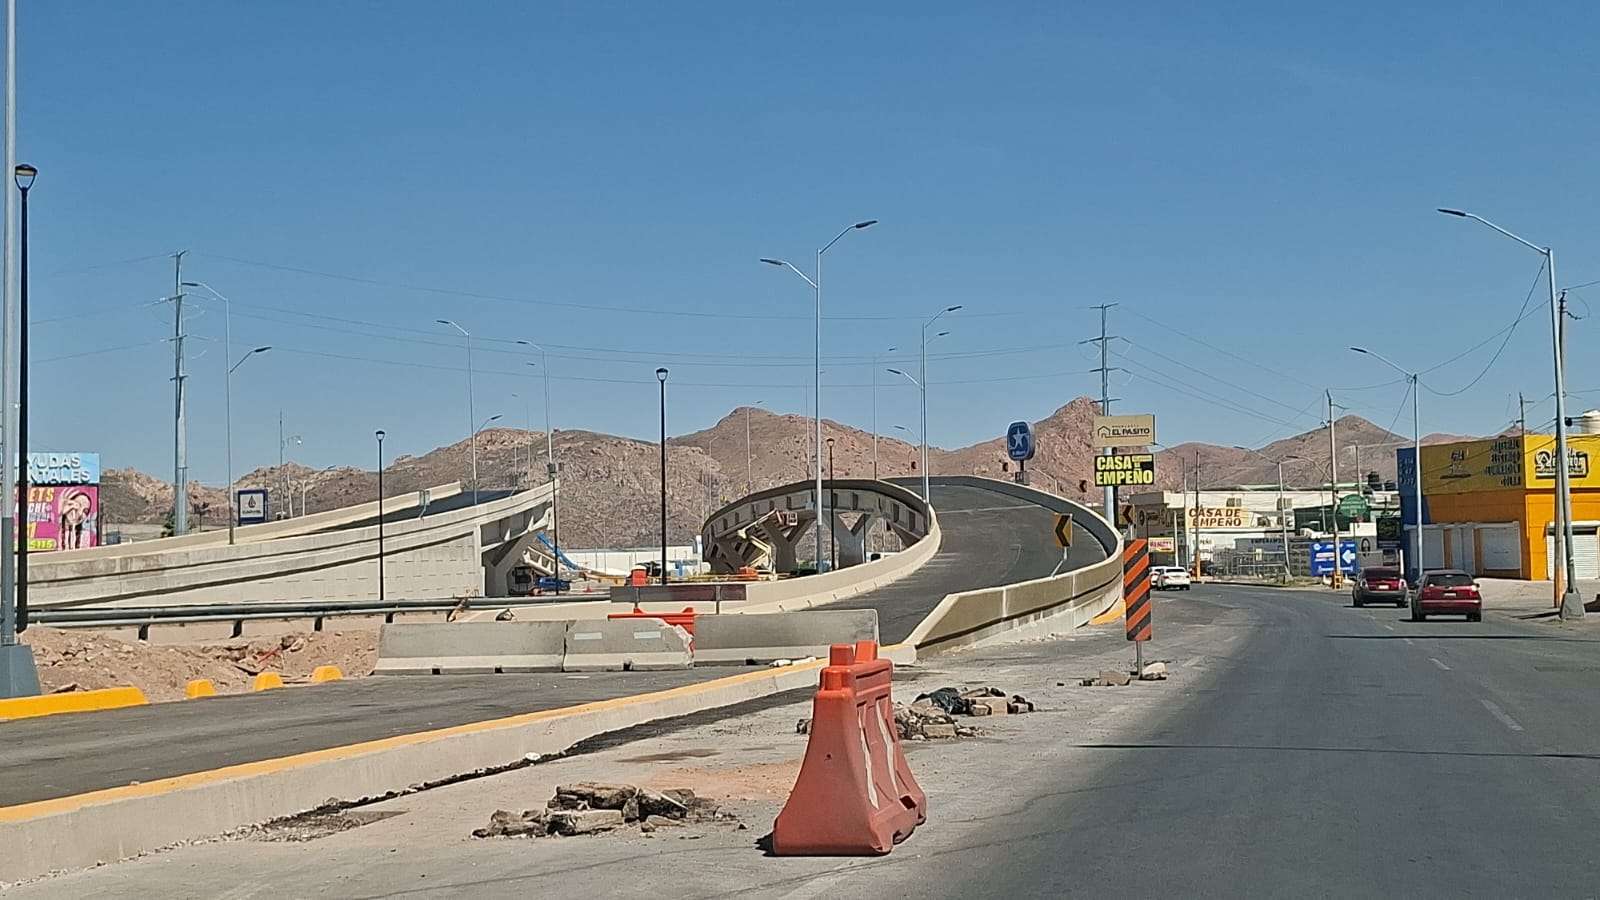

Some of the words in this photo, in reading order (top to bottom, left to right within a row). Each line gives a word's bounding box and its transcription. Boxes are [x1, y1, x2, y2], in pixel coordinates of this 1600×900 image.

[1096, 456, 1133, 470] CASA
[1095, 468, 1153, 485] EMPEÑO
[1188, 507, 1222, 518] CASA
[1225, 507, 1241, 518] DE
[1192, 517, 1242, 527] EMPEÑO
